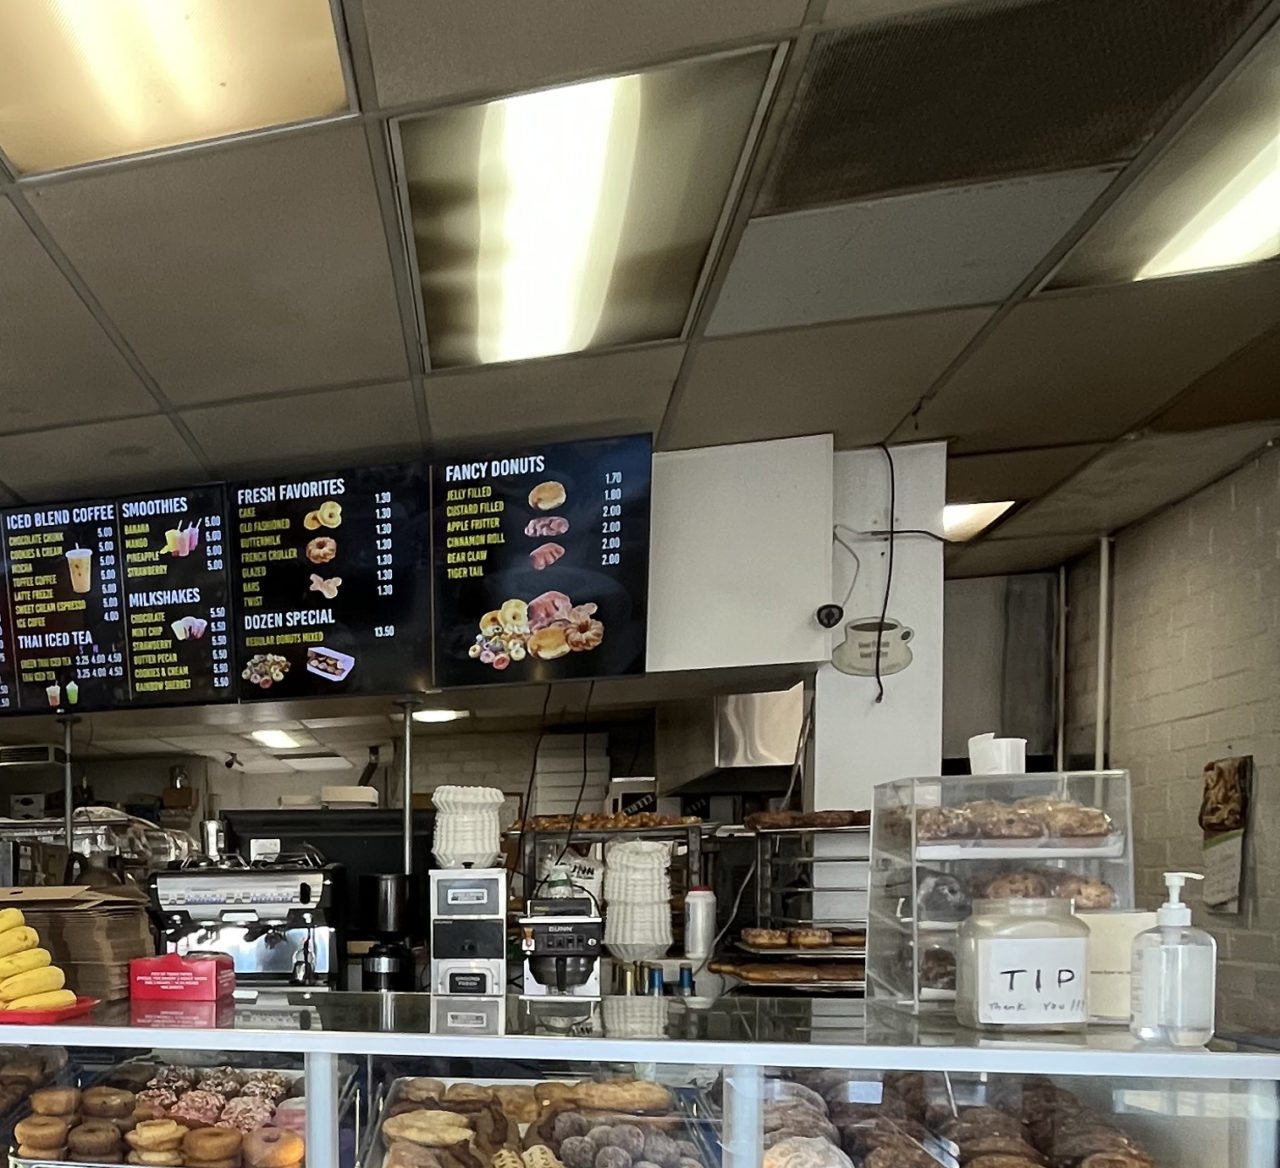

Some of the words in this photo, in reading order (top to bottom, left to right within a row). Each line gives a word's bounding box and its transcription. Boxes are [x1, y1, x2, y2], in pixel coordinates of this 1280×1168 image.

[446, 461, 488, 481] FANCY
[492, 456, 545, 477] DONUTS
[606, 472, 622, 484] 1.70
[238, 487, 275, 504] FRESH
[280, 478, 345, 500] FAVORITES
[447, 489, 466, 501] JELLY
[468, 486, 491, 499] FILLED
[375, 492, 390, 503] 1.30
[122, 497, 187, 518] SMOOTHIES
[239, 507, 256, 518] CAKE
[447, 504, 478, 517] CUSTARD
[480, 501, 504, 512] FILLED
[603, 505, 621, 517] 2.00
[7, 514, 31, 529] ICED
[34, 510, 70, 527] BLEND
[73, 505, 114, 523] COFFEE
[376, 508, 391, 519] 1.30
[205, 516, 220, 527] 5.00
[240, 523, 252, 533] OLD
[254, 519, 290, 531] FASHIONED
[447, 520, 468, 532] APPLE
[471, 518, 499, 530] FRITTER
[602, 521, 620, 533] 2.00
[98, 527, 112, 537] 5.00
[376, 523, 391, 534] 1.30
[206, 531, 221, 542] 5.00
[241, 535, 281, 548] BUTTERMILK
[447, 535, 485, 548] CINNAMON
[487, 533, 505, 544] ROLL
[99, 541, 113, 552] 5.00
[376, 539, 391, 550] 1.30
[602, 537, 620, 550] 2.00
[207, 545, 222, 556] 5.00
[100, 555, 115, 565] 5.00
[127, 551, 159, 563] PINEAPPLE
[241, 552, 267, 563] FRENCH
[377, 554, 392, 565] 1.30
[448, 553, 465, 563] BEAR
[468, 551, 487, 561] CLAW
[602, 553, 620, 565] 2.00
[207, 559, 222, 570] 5.00
[101, 569, 115, 580] 5.00
[242, 567, 266, 578] GLAZED
[377, 569, 392, 580] 1.30
[448, 568, 468, 579] TIGER
[469, 566, 484, 577] TAIL
[102, 583, 116, 594] 5.00
[377, 584, 392, 596] 1.30
[14, 591, 31, 601] LATTE
[129, 588, 200, 607] MILKSHAKES
[244, 596, 262, 607] TWIST
[103, 597, 118, 607] 5.00
[104, 611, 119, 621] 4.00
[245, 613, 282, 630] DOZEN
[286, 609, 335, 626] SPECIAL
[18, 635, 42, 649] THAI
[45, 633, 69, 647] ICED
[72, 630, 92, 645] TEA
[246, 635, 275, 647] REGULAR
[276, 633, 301, 644] DONUTS
[303, 632, 324, 642] MIXED
[91, 655, 105, 664] 4.00
[108, 653, 122, 662] 4.50
[92, 668, 106, 677] 4.00
[109, 667, 123, 676] 4.50
[1000, 969, 1075, 992] TIP
[989, 1002, 1026, 1011] Thank
